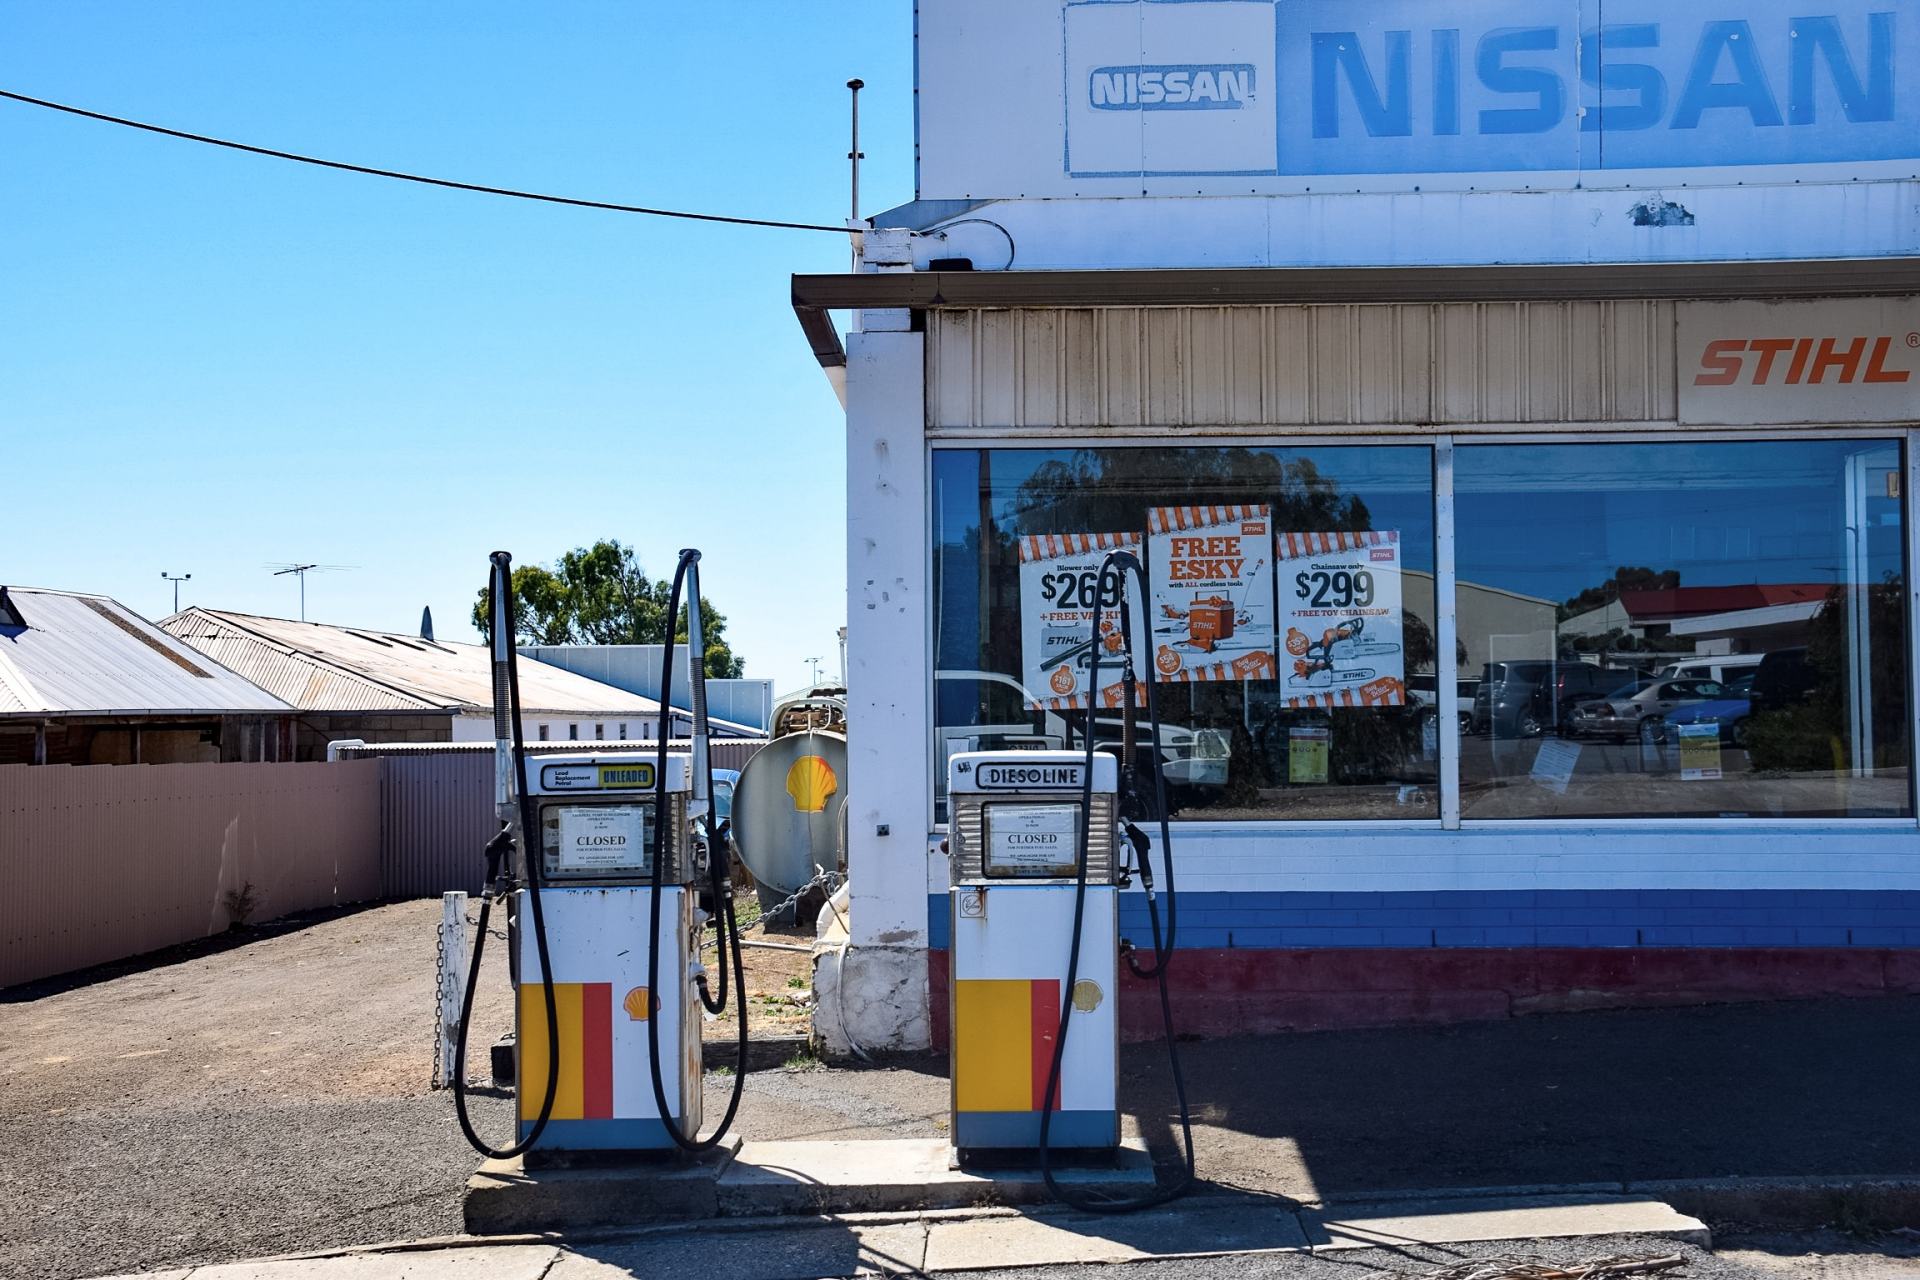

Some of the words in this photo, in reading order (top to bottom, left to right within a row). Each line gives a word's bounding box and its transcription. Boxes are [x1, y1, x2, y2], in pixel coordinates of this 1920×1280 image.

[1310, 12, 1896, 139] NISSAN
[1092, 70, 1249, 105] NISSAN
[1693, 337, 1910, 386] STIHL
[1171, 537, 1241, 557] FREE
[1084, 564, 1100, 572] only
[1169, 559, 1245, 580] ESKY
[1041, 571, 1120, 609] $269
[1295, 570, 1375, 608] $299
[1049, 612, 1078, 620] FREE
[1340, 608, 1390, 616] CHAINSAW
[1046, 636, 1082, 645] STIHL
[603, 770, 648, 783] UNLEADED
[990, 768, 1078, 784] DIESOLINE
[576, 836, 626, 846] CLOSED
[1008, 834, 1057, 844] CLOSED
